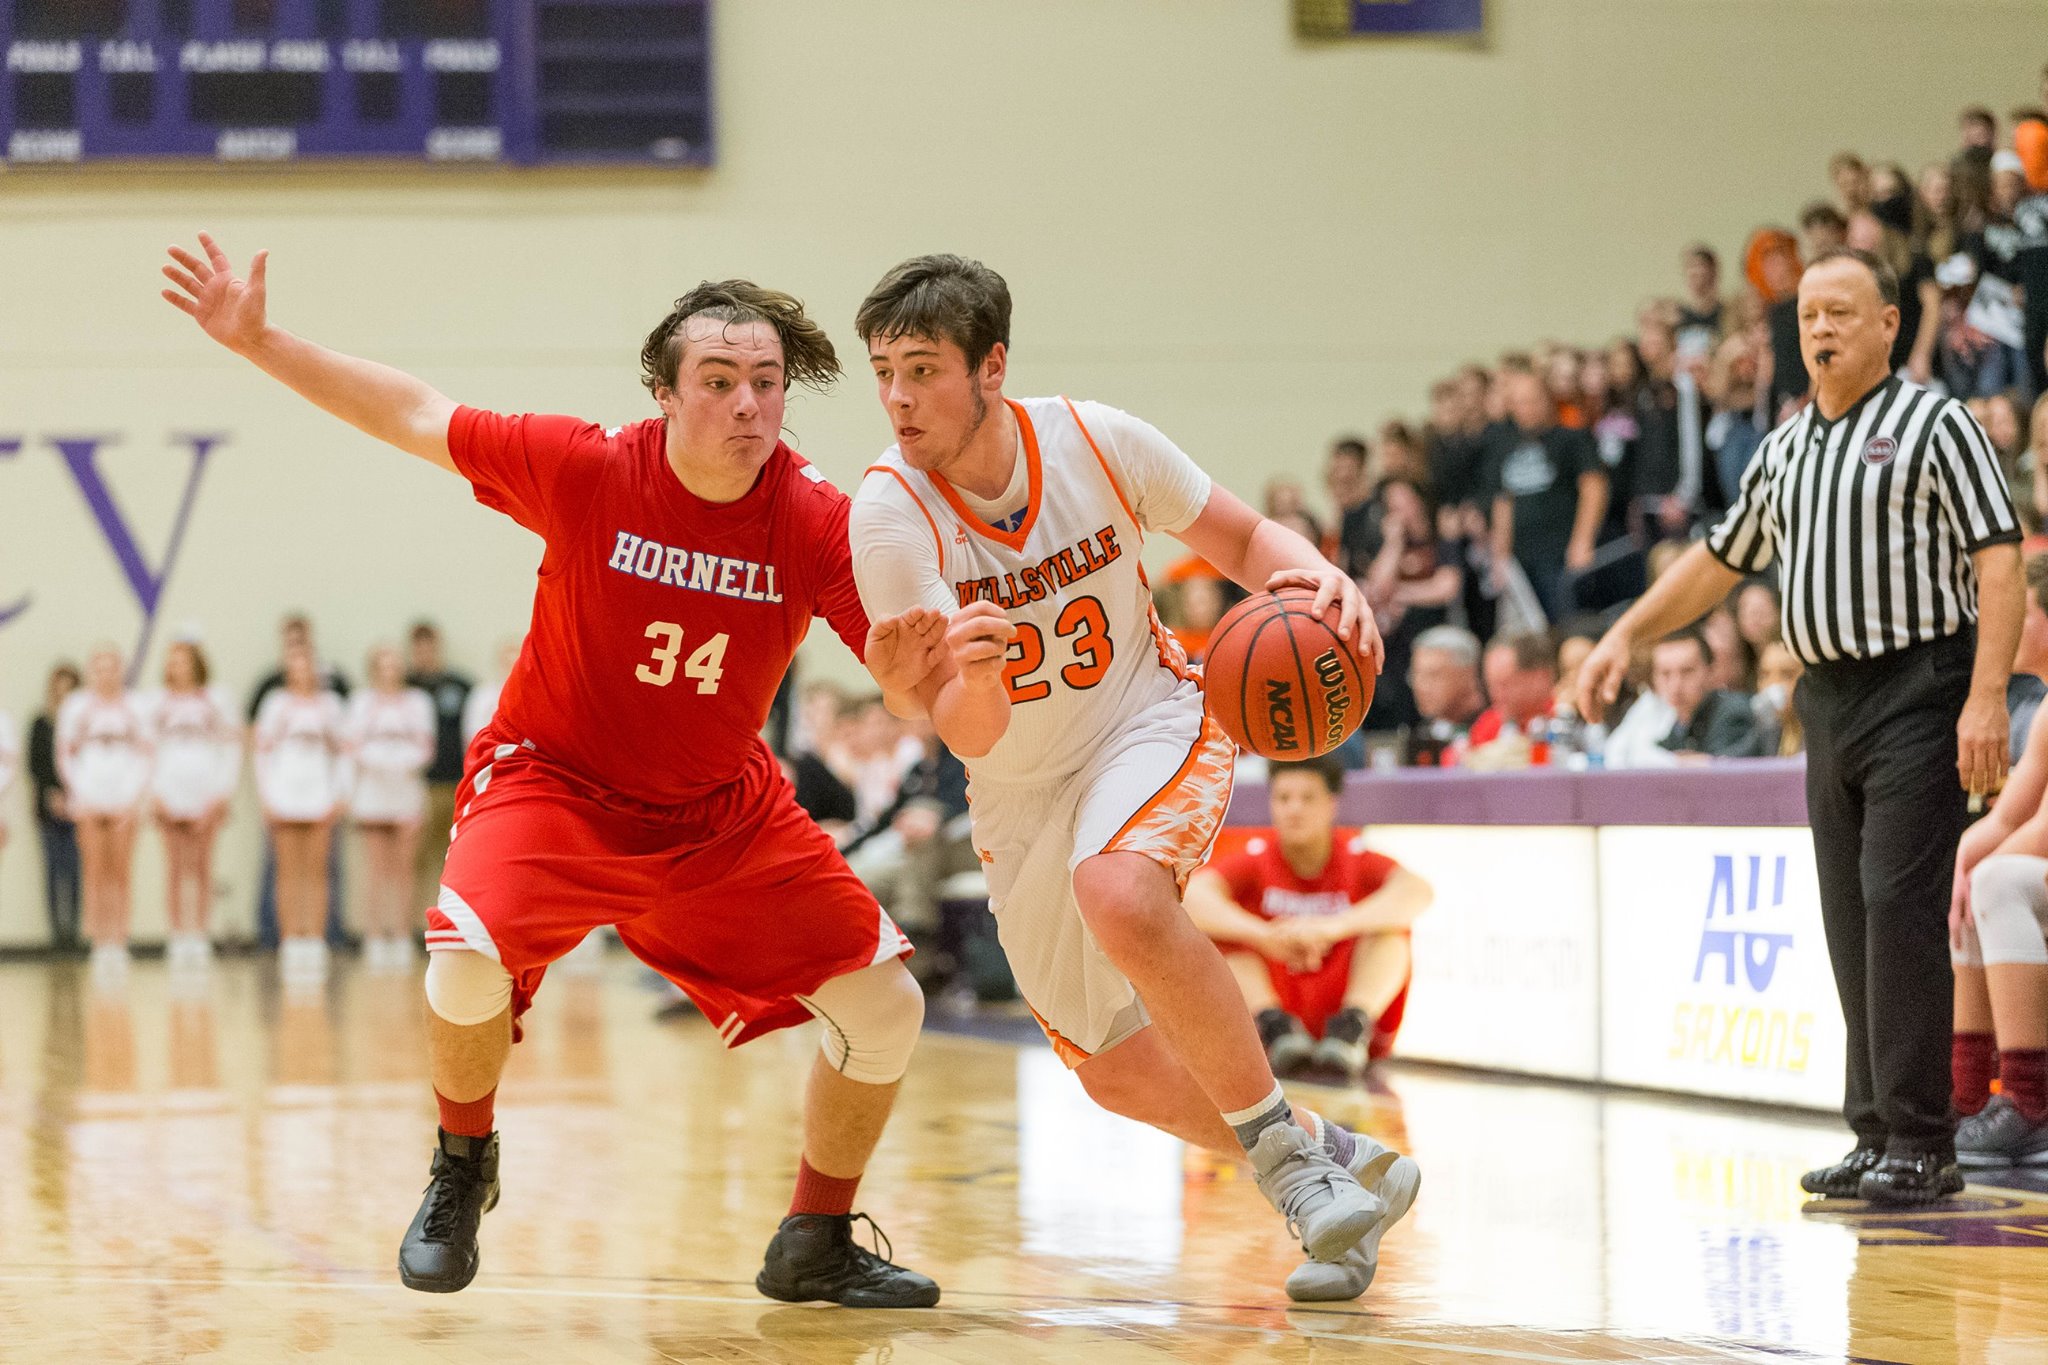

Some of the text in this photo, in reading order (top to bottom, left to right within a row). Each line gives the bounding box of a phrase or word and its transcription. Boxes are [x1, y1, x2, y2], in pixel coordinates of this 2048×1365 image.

[608, 529, 783, 603] HORNELL
[635, 620, 730, 695] 34
[1001, 595, 1114, 705] 23
[1266, 679, 1299, 751] NCAA
[1314, 646, 1352, 753] Wilson
[1668, 1001, 1816, 1074] SAXONS
